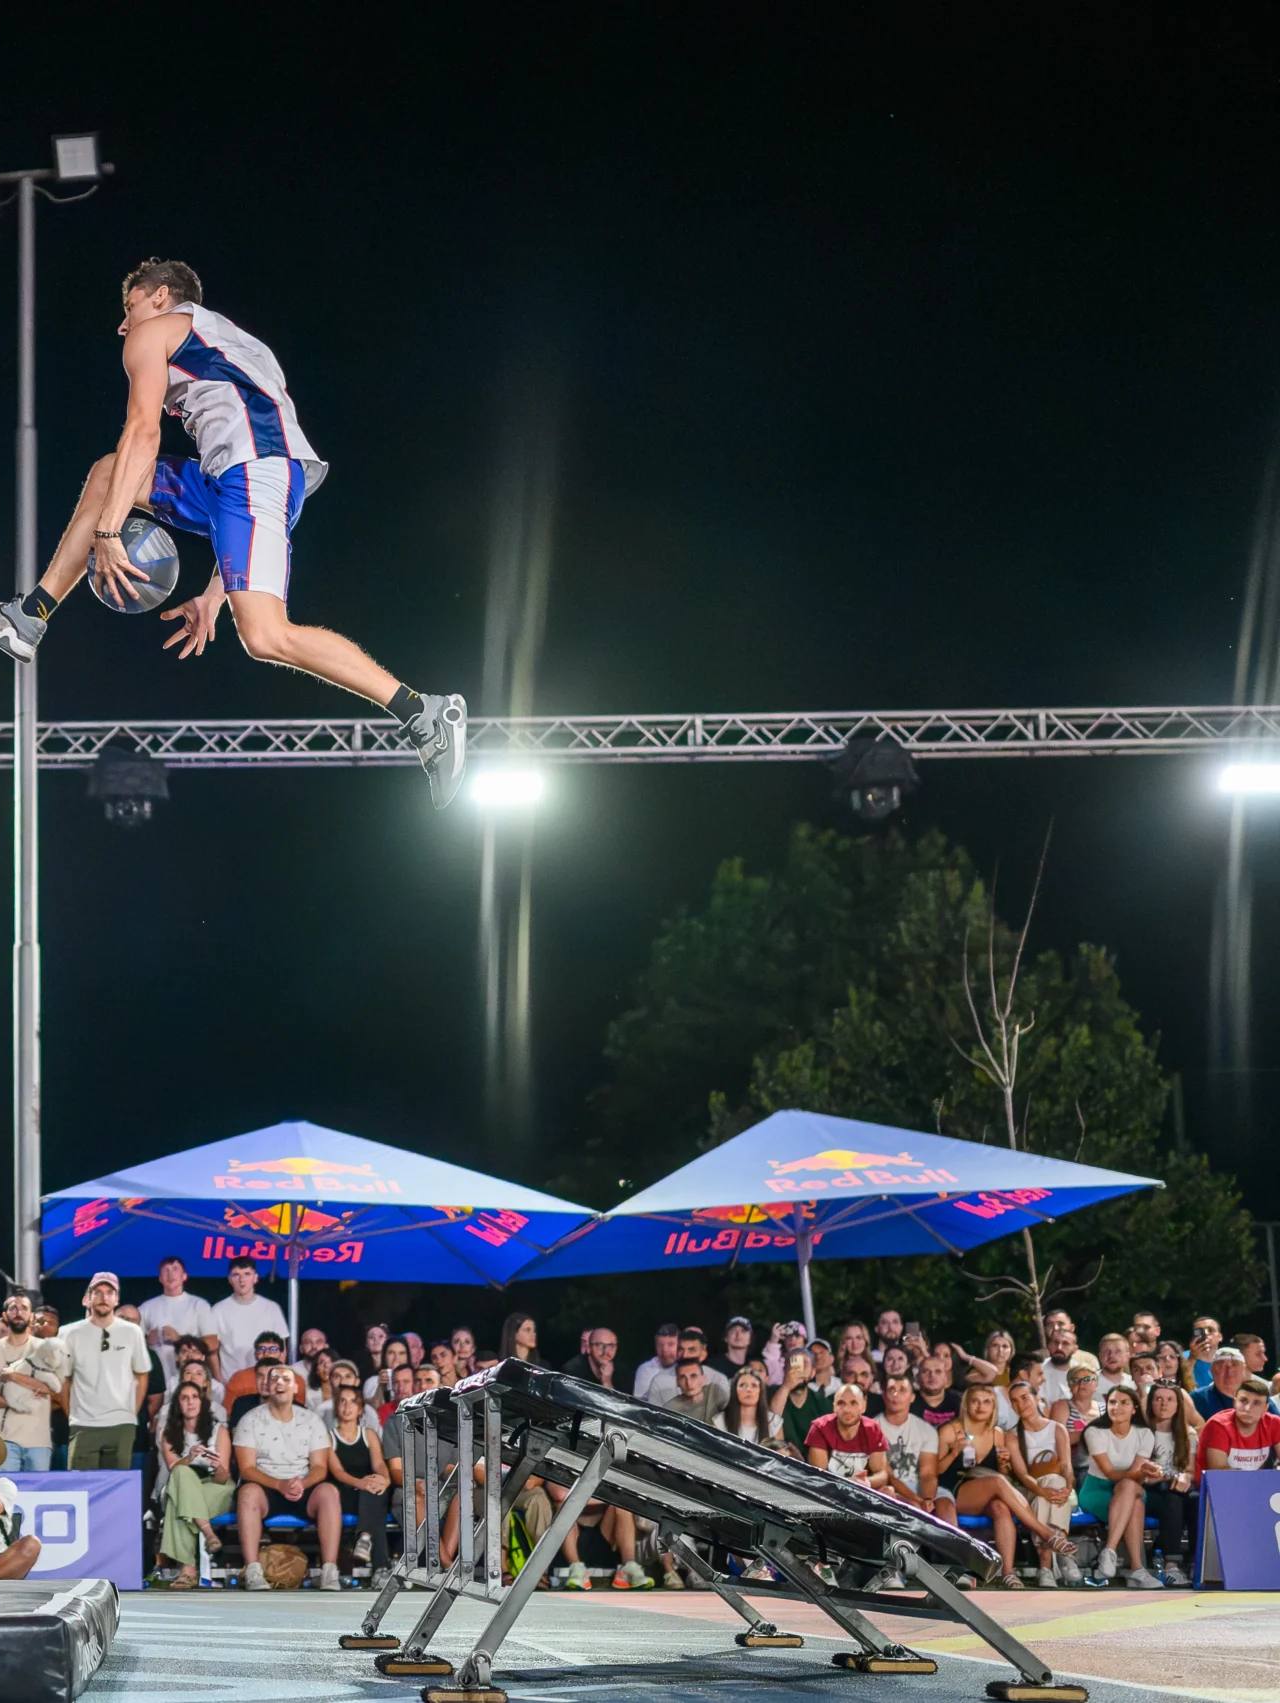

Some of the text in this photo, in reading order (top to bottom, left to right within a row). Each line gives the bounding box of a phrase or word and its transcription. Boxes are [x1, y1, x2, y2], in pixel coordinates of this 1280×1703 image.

[213, 1175, 402, 1194] Red Bull
[764, 1168, 959, 1193] Red Bull
